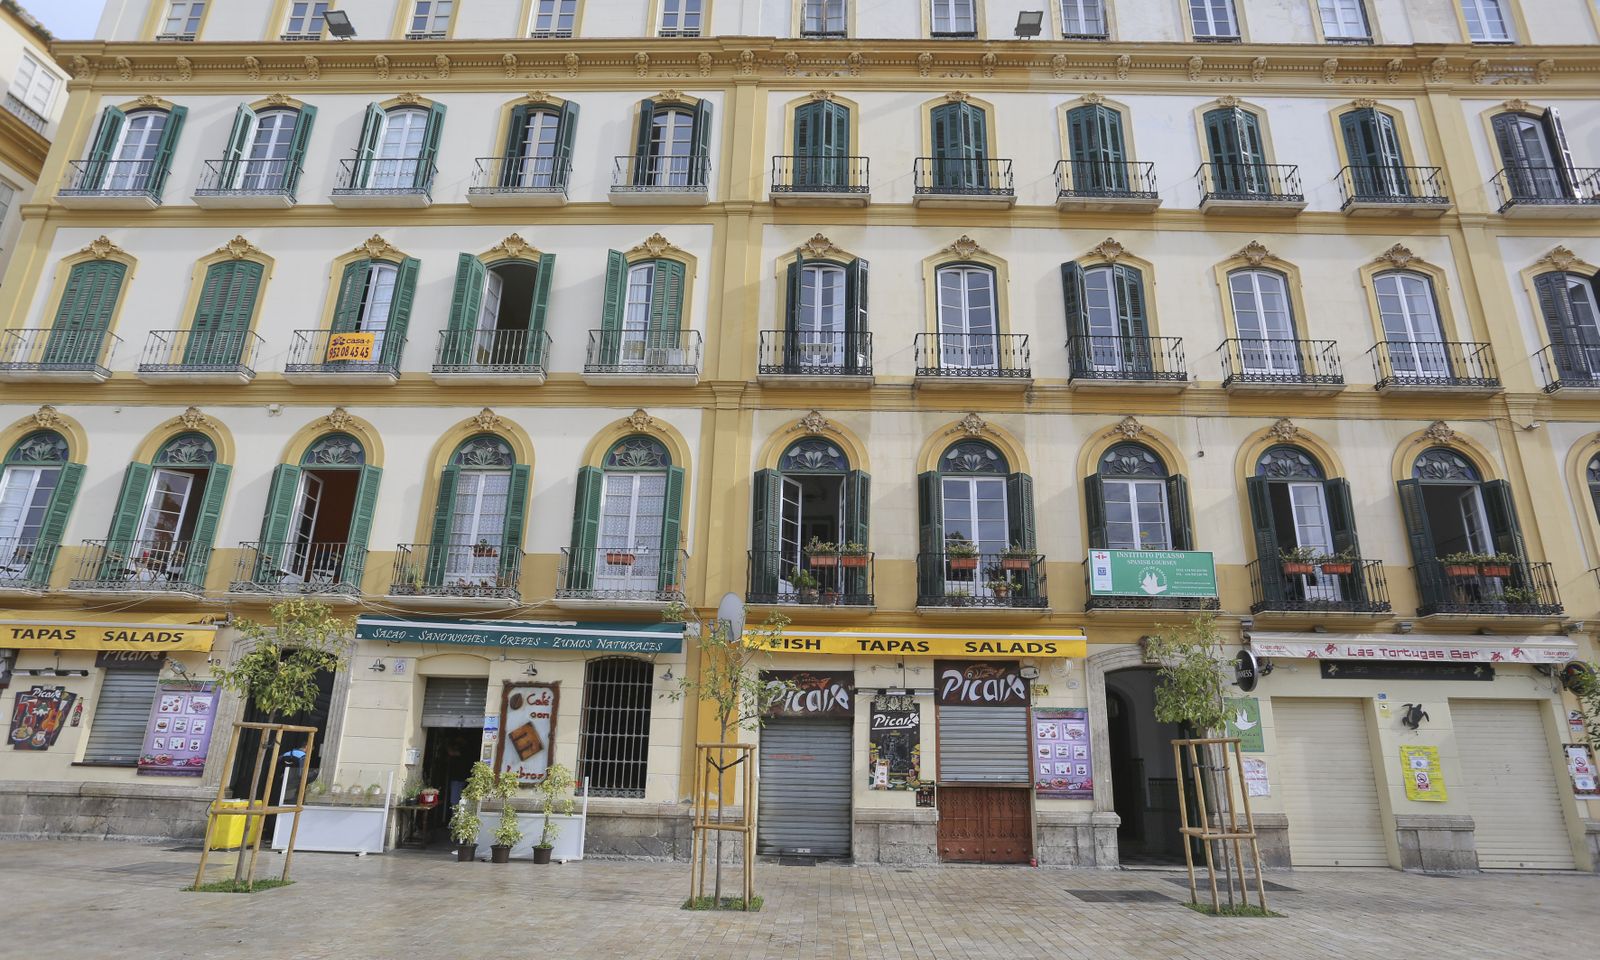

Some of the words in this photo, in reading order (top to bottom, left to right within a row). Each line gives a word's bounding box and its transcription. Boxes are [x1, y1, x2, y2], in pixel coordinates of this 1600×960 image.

[329, 346, 340, 359] 952
[340, 346, 350, 357] 08
[350, 346, 359, 358] 45
[360, 346, 369, 358] 45
[10, 628, 76, 640] TAPAS
[102, 630, 184, 642] SALADS
[770, 638, 821, 650] FISH
[857, 640, 930, 652] TAPAS
[964, 641, 1058, 654] SALADS
[1348, 648, 1374, 657] Las
[1379, 648, 1444, 660] Tortugas
[1450, 650, 1479, 660] Bar
